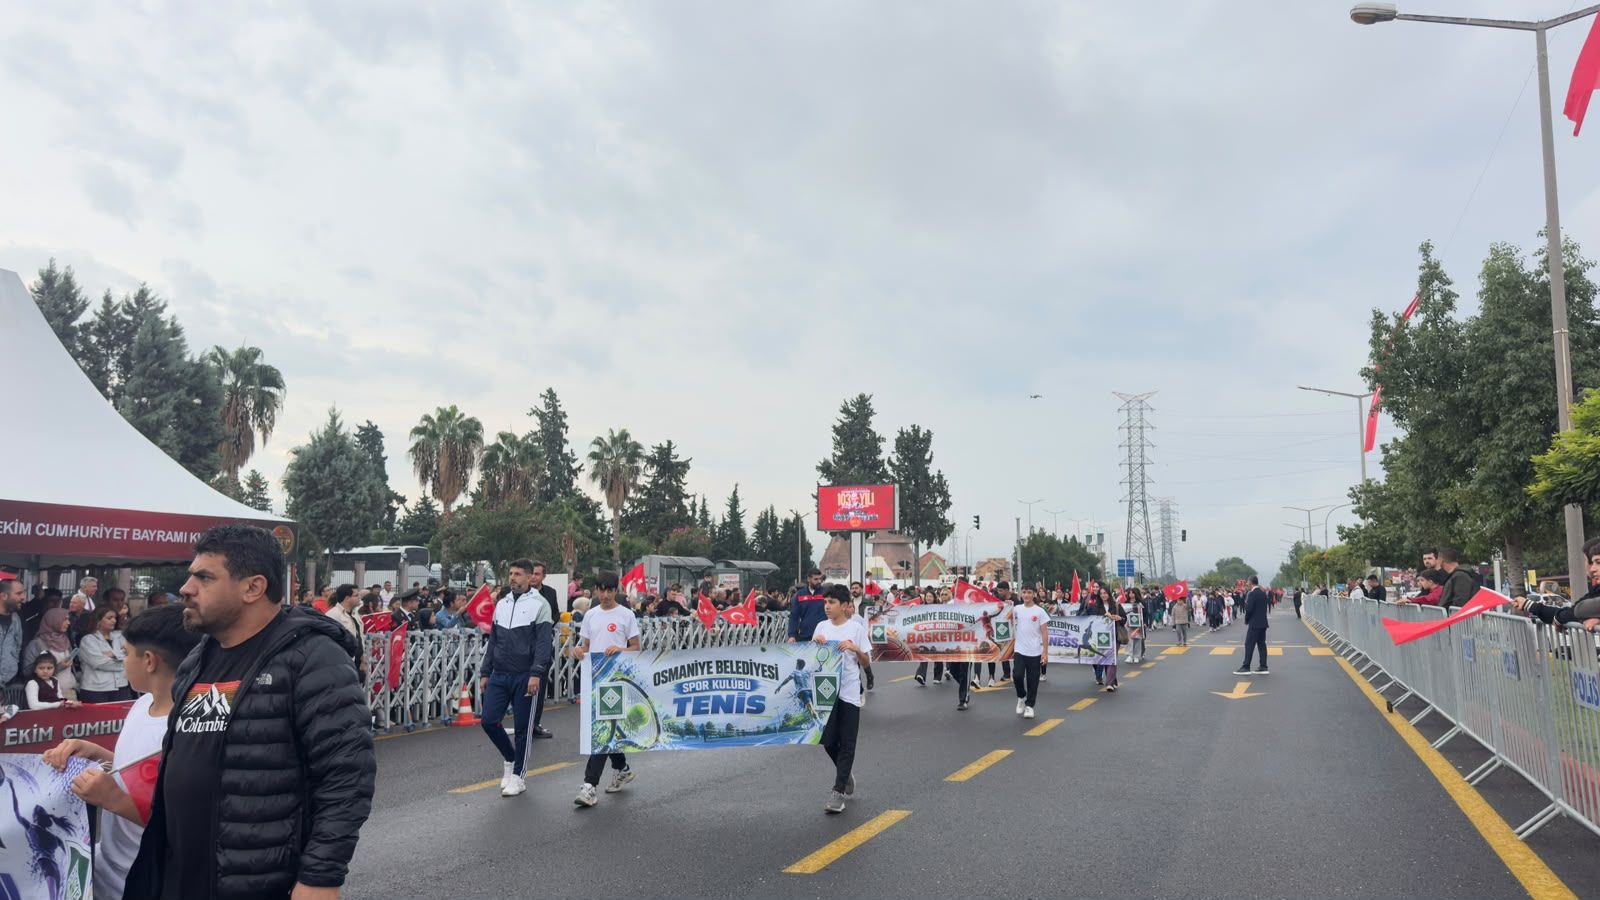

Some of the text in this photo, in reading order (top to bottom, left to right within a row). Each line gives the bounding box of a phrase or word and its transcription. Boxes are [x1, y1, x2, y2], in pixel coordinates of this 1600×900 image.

[35, 522, 130, 540] CUMHURİYET
[132, 528, 187, 543] BAYRAMI
[906, 631, 978, 644] BASKETBOL
[653, 659, 780, 687] OSMANİYE BELEDİYESİ
[682, 676, 751, 693] SPOR KULÜBÜ
[672, 692, 766, 717] TENİS
[4, 724, 54, 746] EKİM
